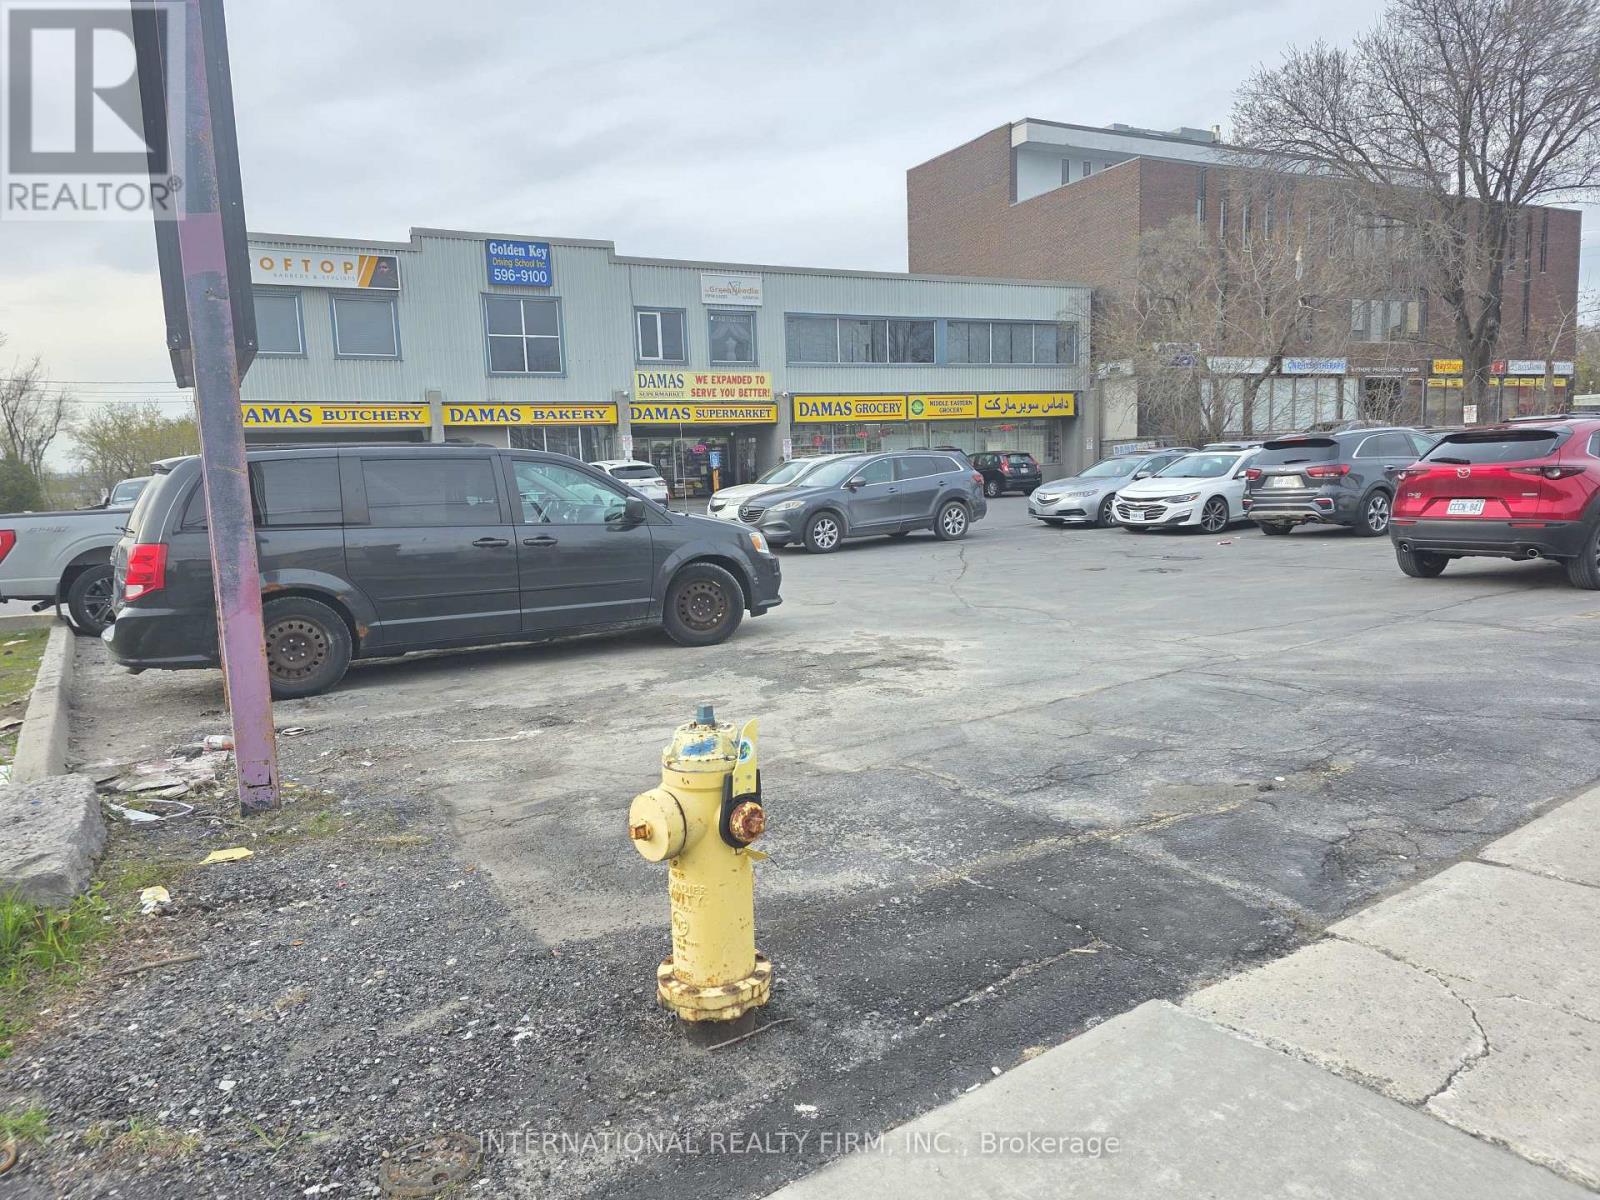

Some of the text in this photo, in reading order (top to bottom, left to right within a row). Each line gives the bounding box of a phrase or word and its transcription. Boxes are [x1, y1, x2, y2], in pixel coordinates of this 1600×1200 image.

[490, 242, 548, 260] Golden Key
[259, 257, 354, 274] OFTOP
[493, 257, 513, 268] Driving
[515, 258, 535, 268] School
[494, 269, 548, 283] 596-9100
[638, 373, 765, 389] DAMAS WE EXPANDED TO
[691, 388, 717, 398] SERVE
[719, 388, 735, 398] YOU
[738, 388, 770, 398] BETTER!
[244, 407, 422, 424] AMAS BUTCHERY
[449, 408, 607, 423] DAMAS BAKERY
[630, 407, 772, 421] DAMAS SUPERMARKET
[798, 400, 903, 417] DAMAS GROCERY
